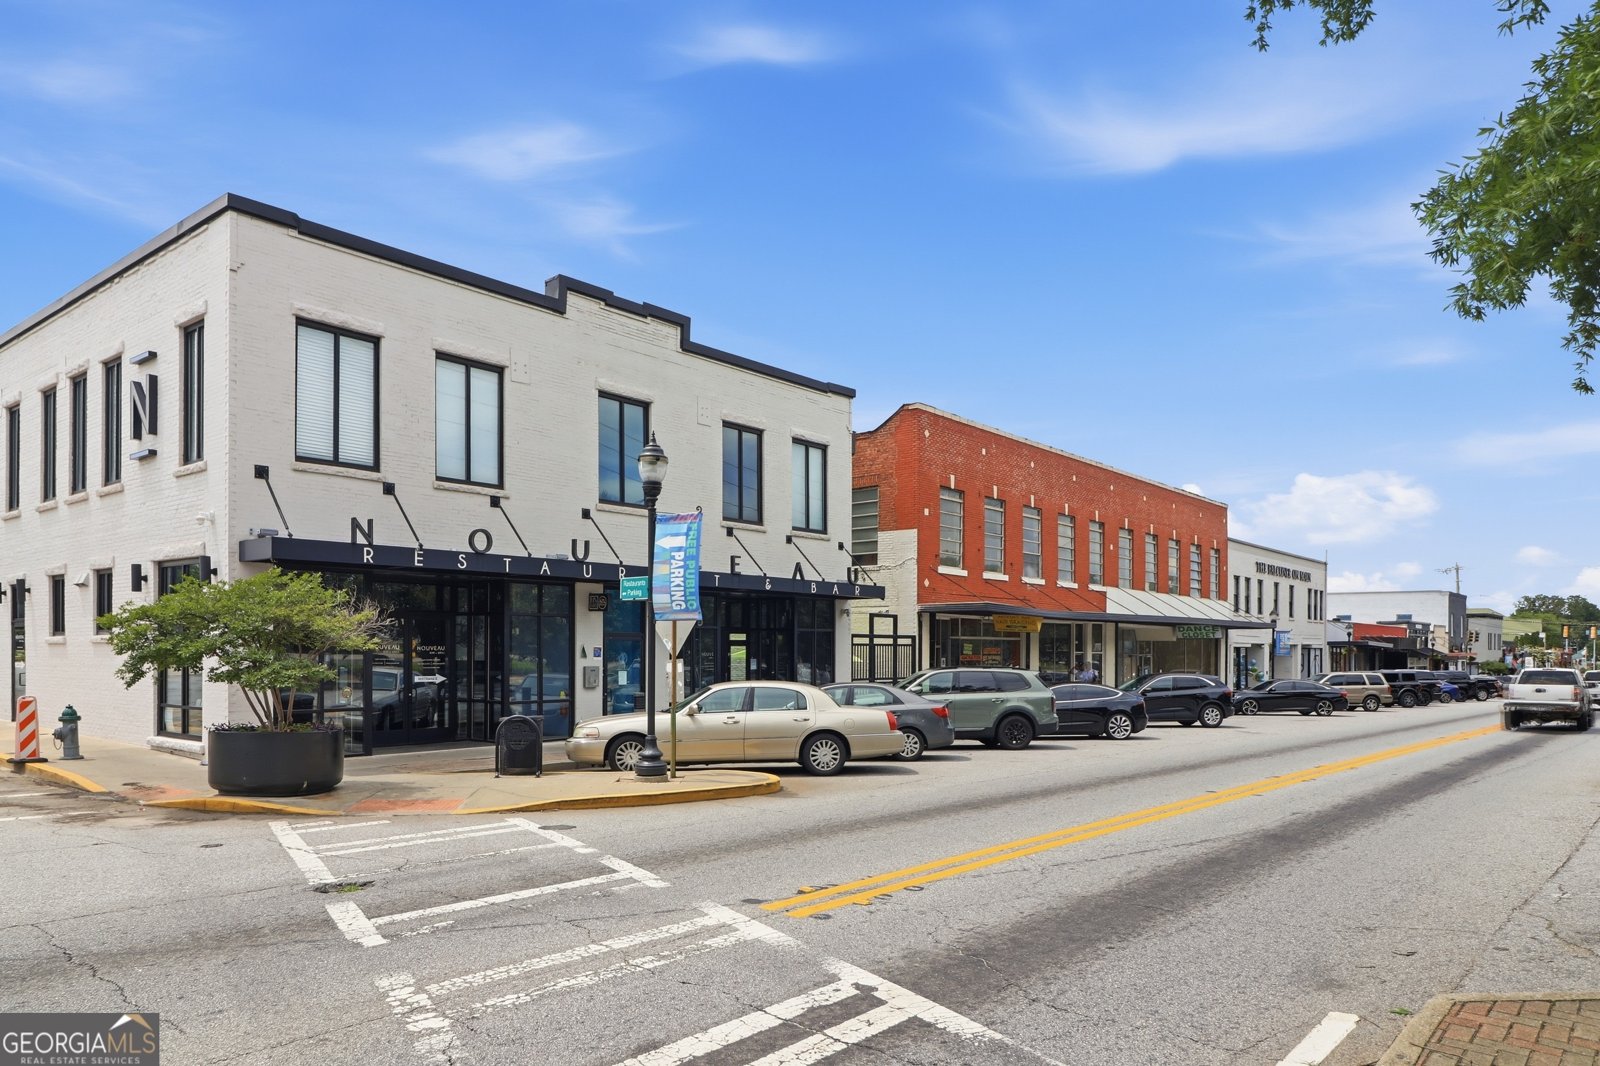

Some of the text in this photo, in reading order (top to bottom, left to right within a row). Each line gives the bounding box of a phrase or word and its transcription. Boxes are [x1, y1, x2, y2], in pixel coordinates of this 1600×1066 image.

[130, 374, 158, 441] N
[351, 517, 858, 585] NOUEAU
[685, 522, 698, 610] FREE PUBLIC
[627, 588, 642, 597] Parking
[670, 551, 686, 610] PARKING
[811, 582, 860, 597] BAR
[1178, 625, 1220, 633] DANCE
[1182, 631, 1217, 639] CLOSET
